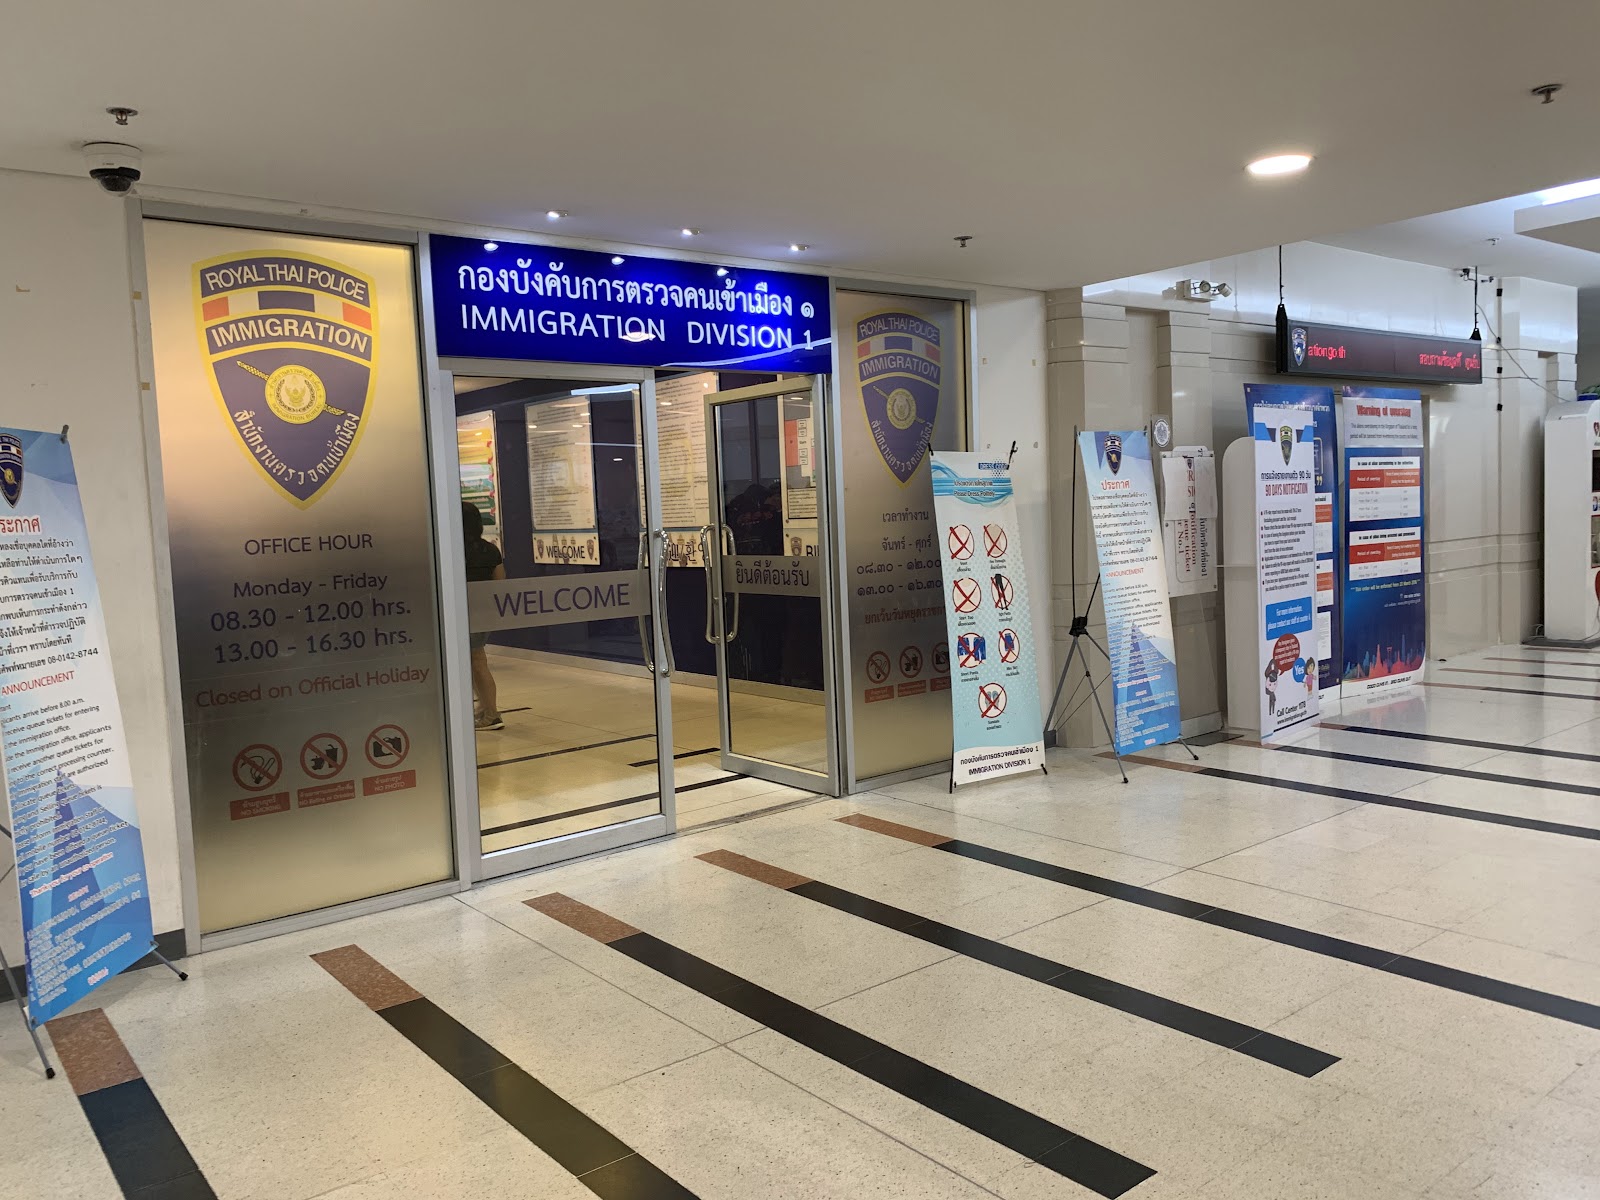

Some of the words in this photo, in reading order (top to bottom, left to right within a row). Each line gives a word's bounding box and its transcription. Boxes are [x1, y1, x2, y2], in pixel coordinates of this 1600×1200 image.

[205, 264, 265, 291] ROYAL
[264, 263, 303, 283] THAI
[307, 268, 366, 301] POLICE
[458, 257, 793, 317] กองบังคับการตรวจคนเข้าเมือง
[801, 300, 814, 318] ๑
[211, 318, 368, 353] IMMIGRATION
[461, 304, 666, 342] IMMIGRATION
[687, 320, 793, 349] DIVISION
[803, 329, 813, 351] 1
[860, 319, 889, 338] ROYAL
[888, 317, 908, 331] THAI
[909, 320, 940, 342] POLICE
[861, 355, 939, 379] IMMIGRATION
[1101, 479, 1130, 491] ประกาศ
[1299, 470, 1305, 479] 90
[1265, 484, 1271, 497] 90
[1272, 483, 1283, 496] DAYS
[1283, 482, 1308, 496] NOTIFICATION
[882, 507, 930, 524] เวลาทำงาน
[244, 536, 312, 556] OFFICE
[318, 533, 374, 552] HOUR
[545, 545, 586, 559] WELCOME
[881, 535, 906, 552] จันทร์
[914, 533, 932, 552] ศุกร์
[735, 559, 810, 587] ยินดีต้อนรับ
[233, 577, 313, 599] Monday
[333, 572, 388, 591] Friday
[494, 583, 631, 618] WELCOME
[210, 607, 277, 632] 08.30
[304, 599, 364, 624] 12.00
[371, 597, 412, 617] hrs.
[47, 647, 99, 665] 08-0142-8744
[214, 638, 279, 664] 13.00
[306, 629, 366, 654] 16.30
[374, 627, 414, 647] hrs.
[1294, 664, 1305, 676] Yes
[1, 670, 75, 696] ANNOUNCEMENT
[196, 682, 262, 708] Closed
[268, 686, 293, 699] on
[297, 672, 362, 695] Official
[366, 665, 430, 687] Holiday
[22, 710, 39, 719] arrive
[40, 704, 59, 714] before
[26, 720, 46, 731] queue
[46, 714, 64, 724] tickets
[64, 711, 73, 719] for
[74, 705, 100, 716] entering
[1277, 707, 1285, 718] Call
[1285, 705, 1298, 715] Center
[78, 724, 112, 739] applicants
[32, 754, 55, 766] another
[56, 747, 73, 758] queue
[74, 741, 94, 751] tickets
[86, 747, 115, 759] counter.
[76, 758, 109, 775] authorized
[968, 762, 1004, 776] IMMIGRATION
[1004, 759, 1027, 769] DIVISION
[374, 784, 384, 792] NO
[384, 781, 406, 791] PHOTO
[240, 808, 253, 816] NO
[253, 804, 282, 815] SMOKING
